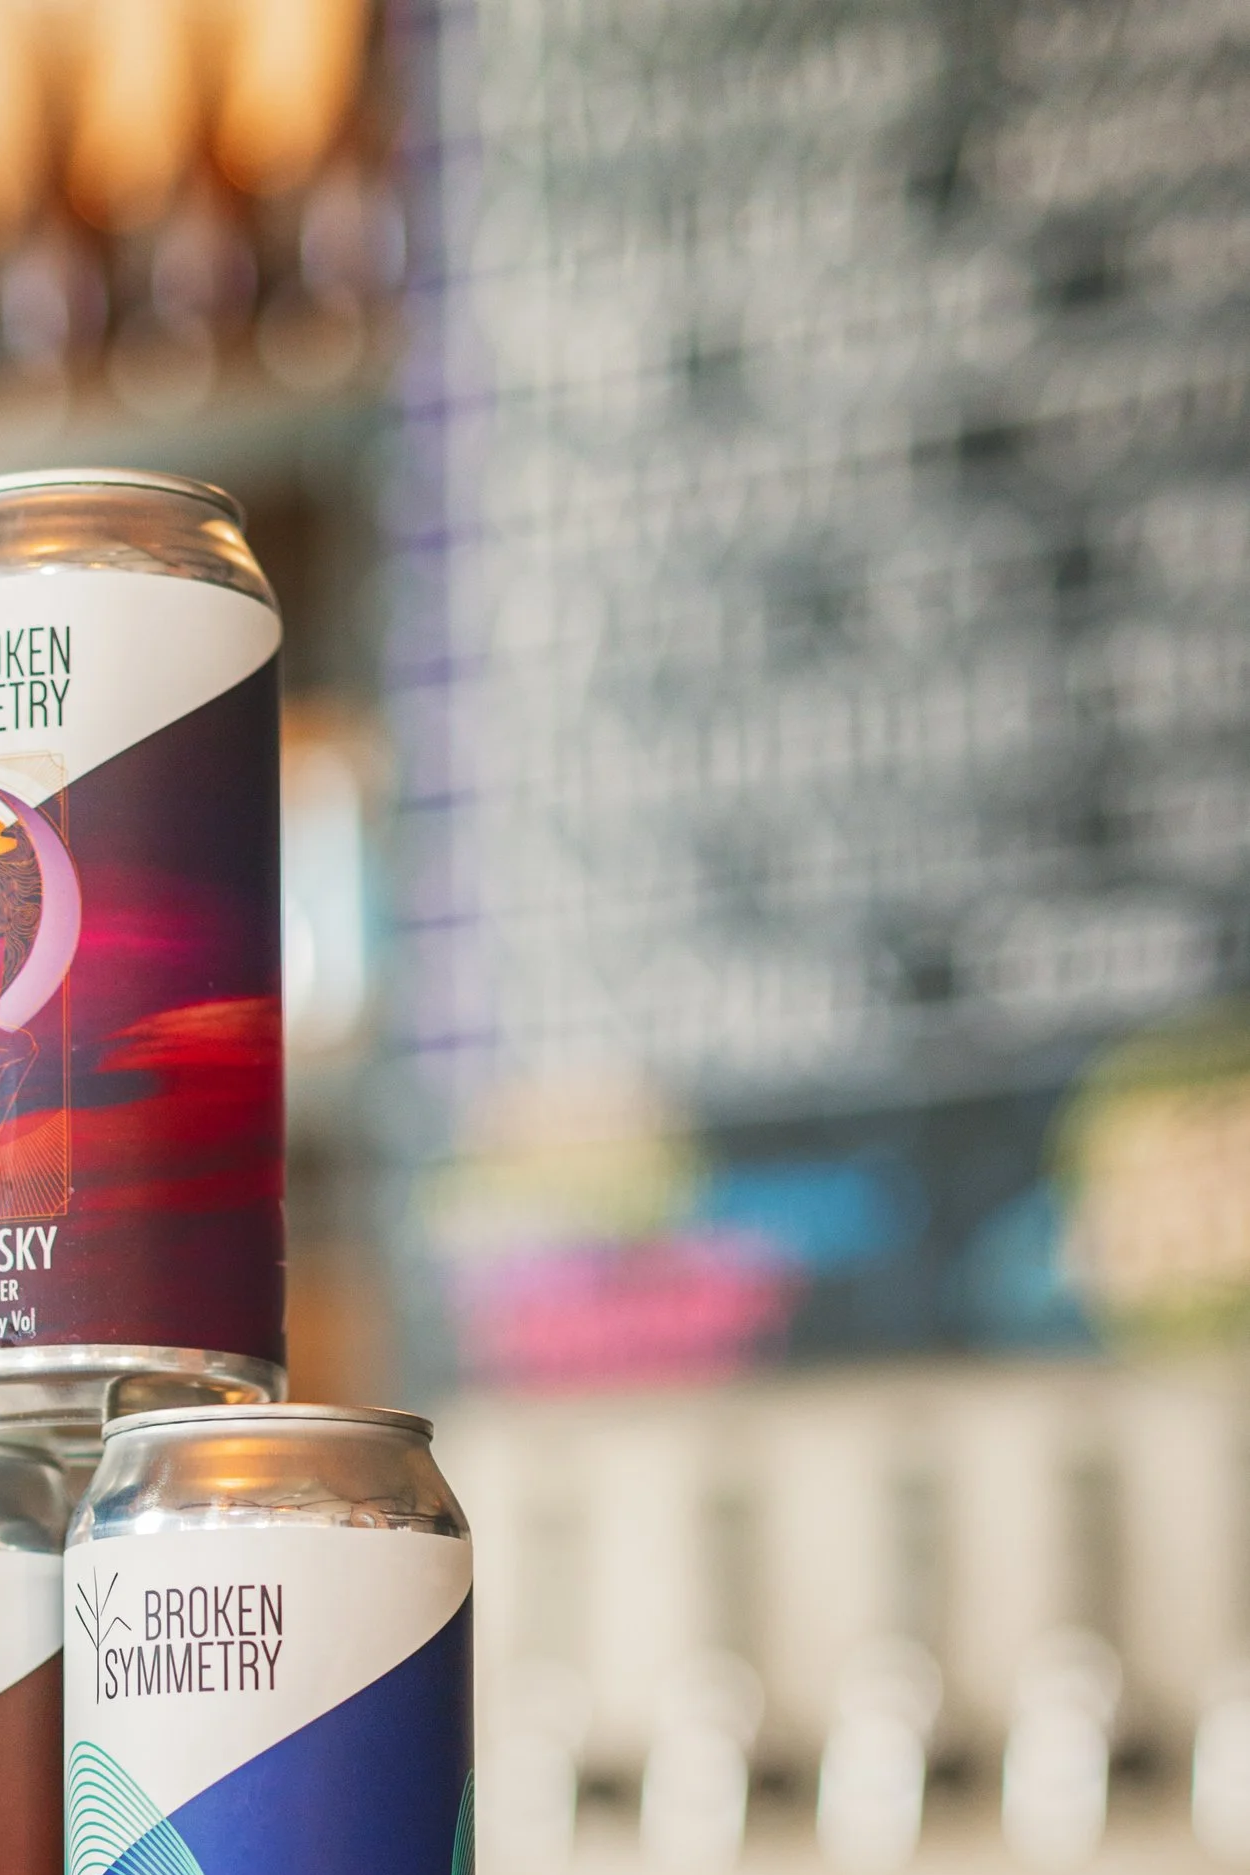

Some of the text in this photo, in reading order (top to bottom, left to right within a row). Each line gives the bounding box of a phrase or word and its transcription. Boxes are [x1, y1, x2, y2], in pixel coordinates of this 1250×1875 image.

[11, 1307, 36, 1333] Vol
[145, 1584, 283, 1641] BROKEN
[105, 1639, 283, 1700] SYMMETRY
